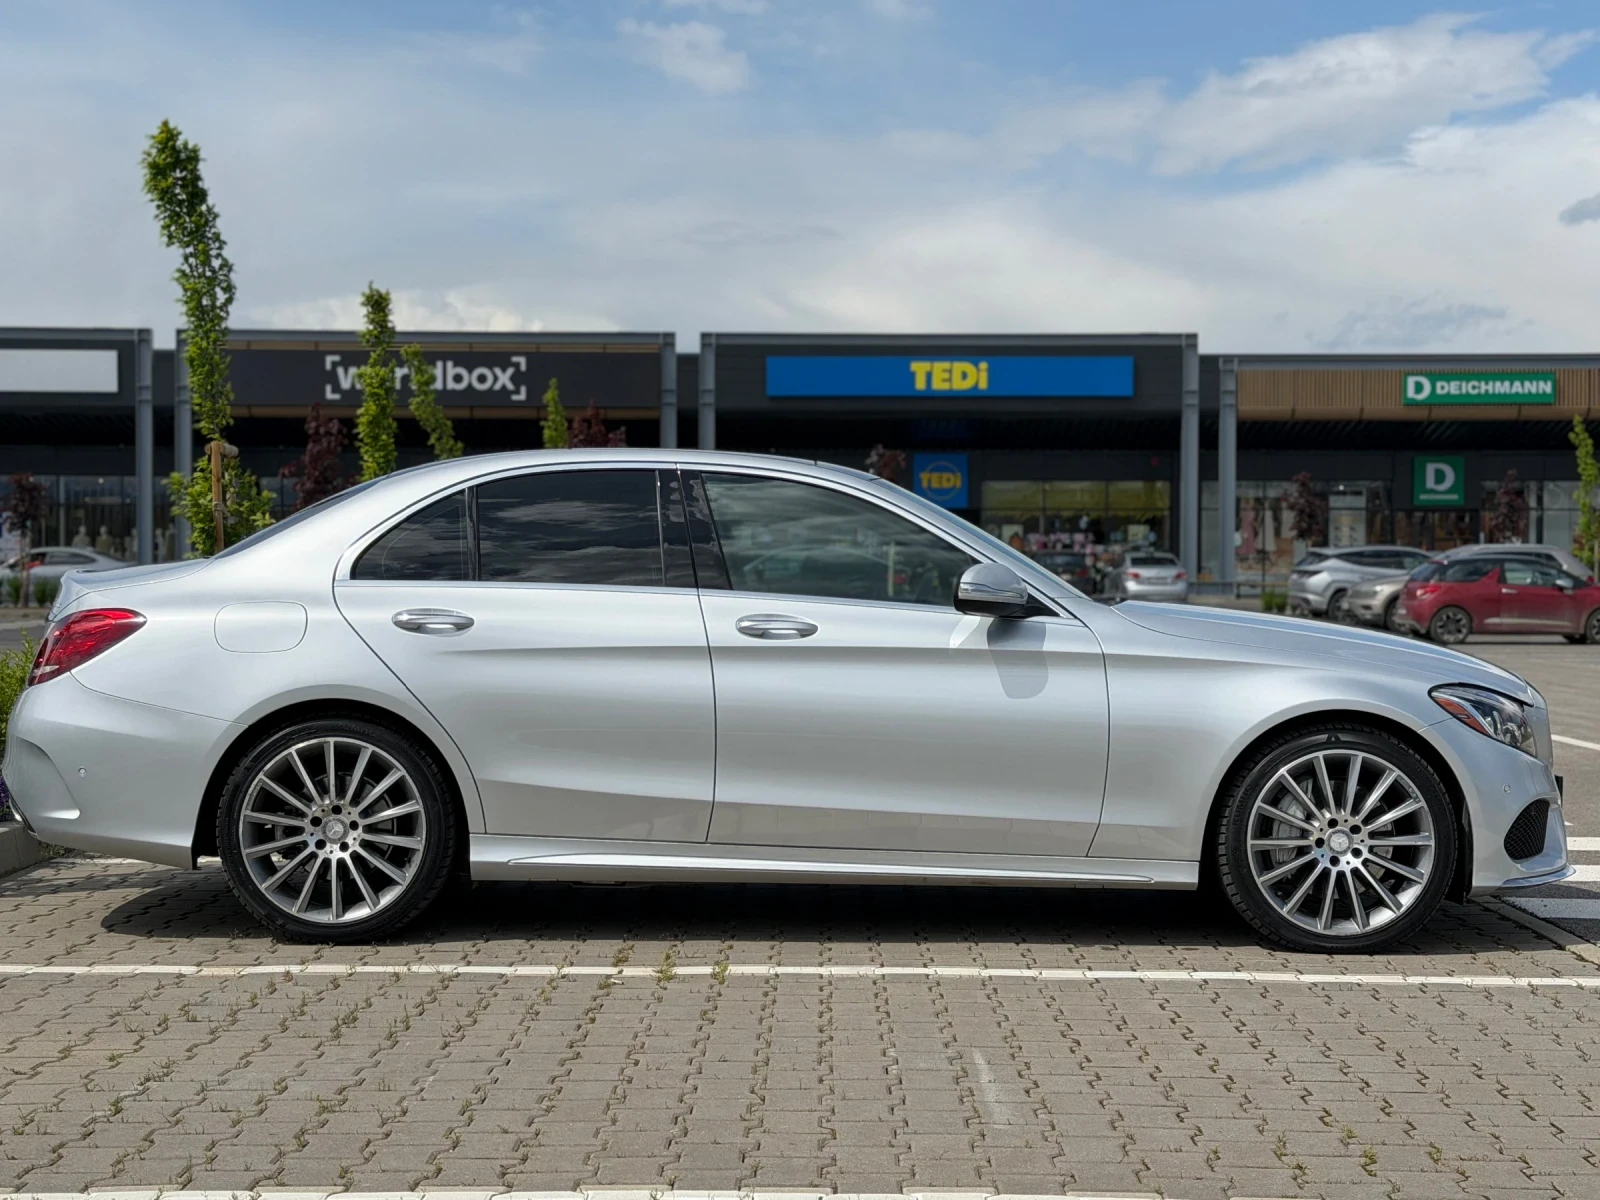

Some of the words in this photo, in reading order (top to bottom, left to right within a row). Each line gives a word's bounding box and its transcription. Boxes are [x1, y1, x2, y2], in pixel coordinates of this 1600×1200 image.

[336, 360, 515, 391] wrdbox
[910, 361, 988, 390] TEDi
[1406, 376, 1431, 399] D
[1436, 380, 1551, 394] DEICHMANN
[919, 473, 961, 488] TEDi
[1425, 462, 1454, 491] D
